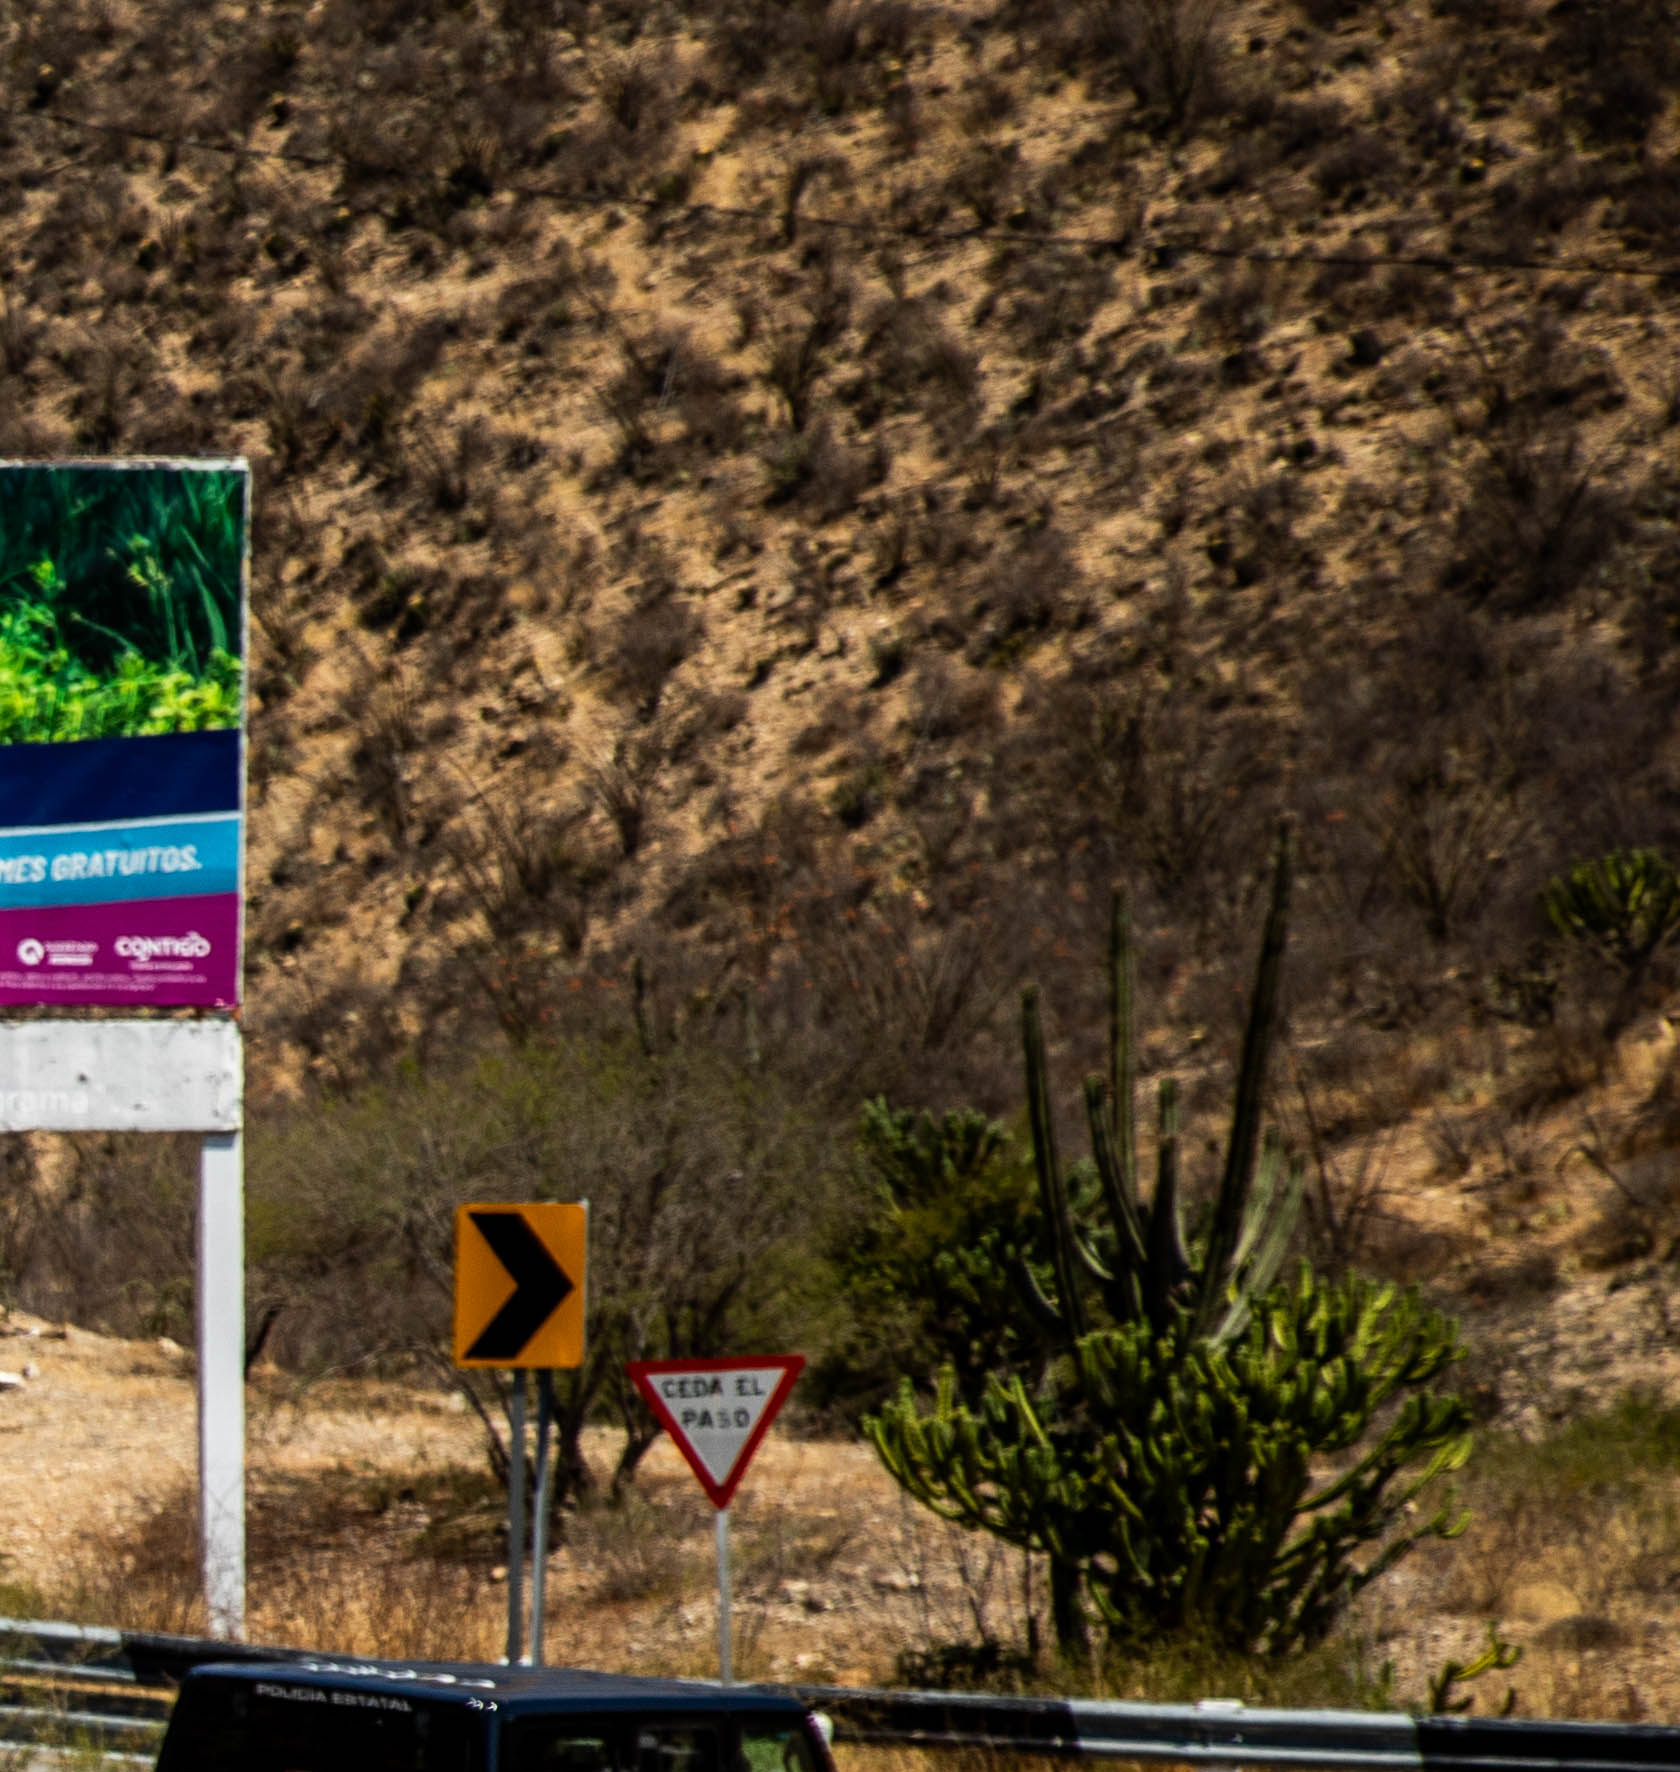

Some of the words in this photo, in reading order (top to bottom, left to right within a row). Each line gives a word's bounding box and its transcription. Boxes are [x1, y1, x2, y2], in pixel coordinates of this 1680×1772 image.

[50, 845, 203, 882] GRATUITOS.
[661, 1376, 725, 1399] CEDA
[735, 1375, 767, 1397] EL
[681, 1408, 751, 1430] PASO
